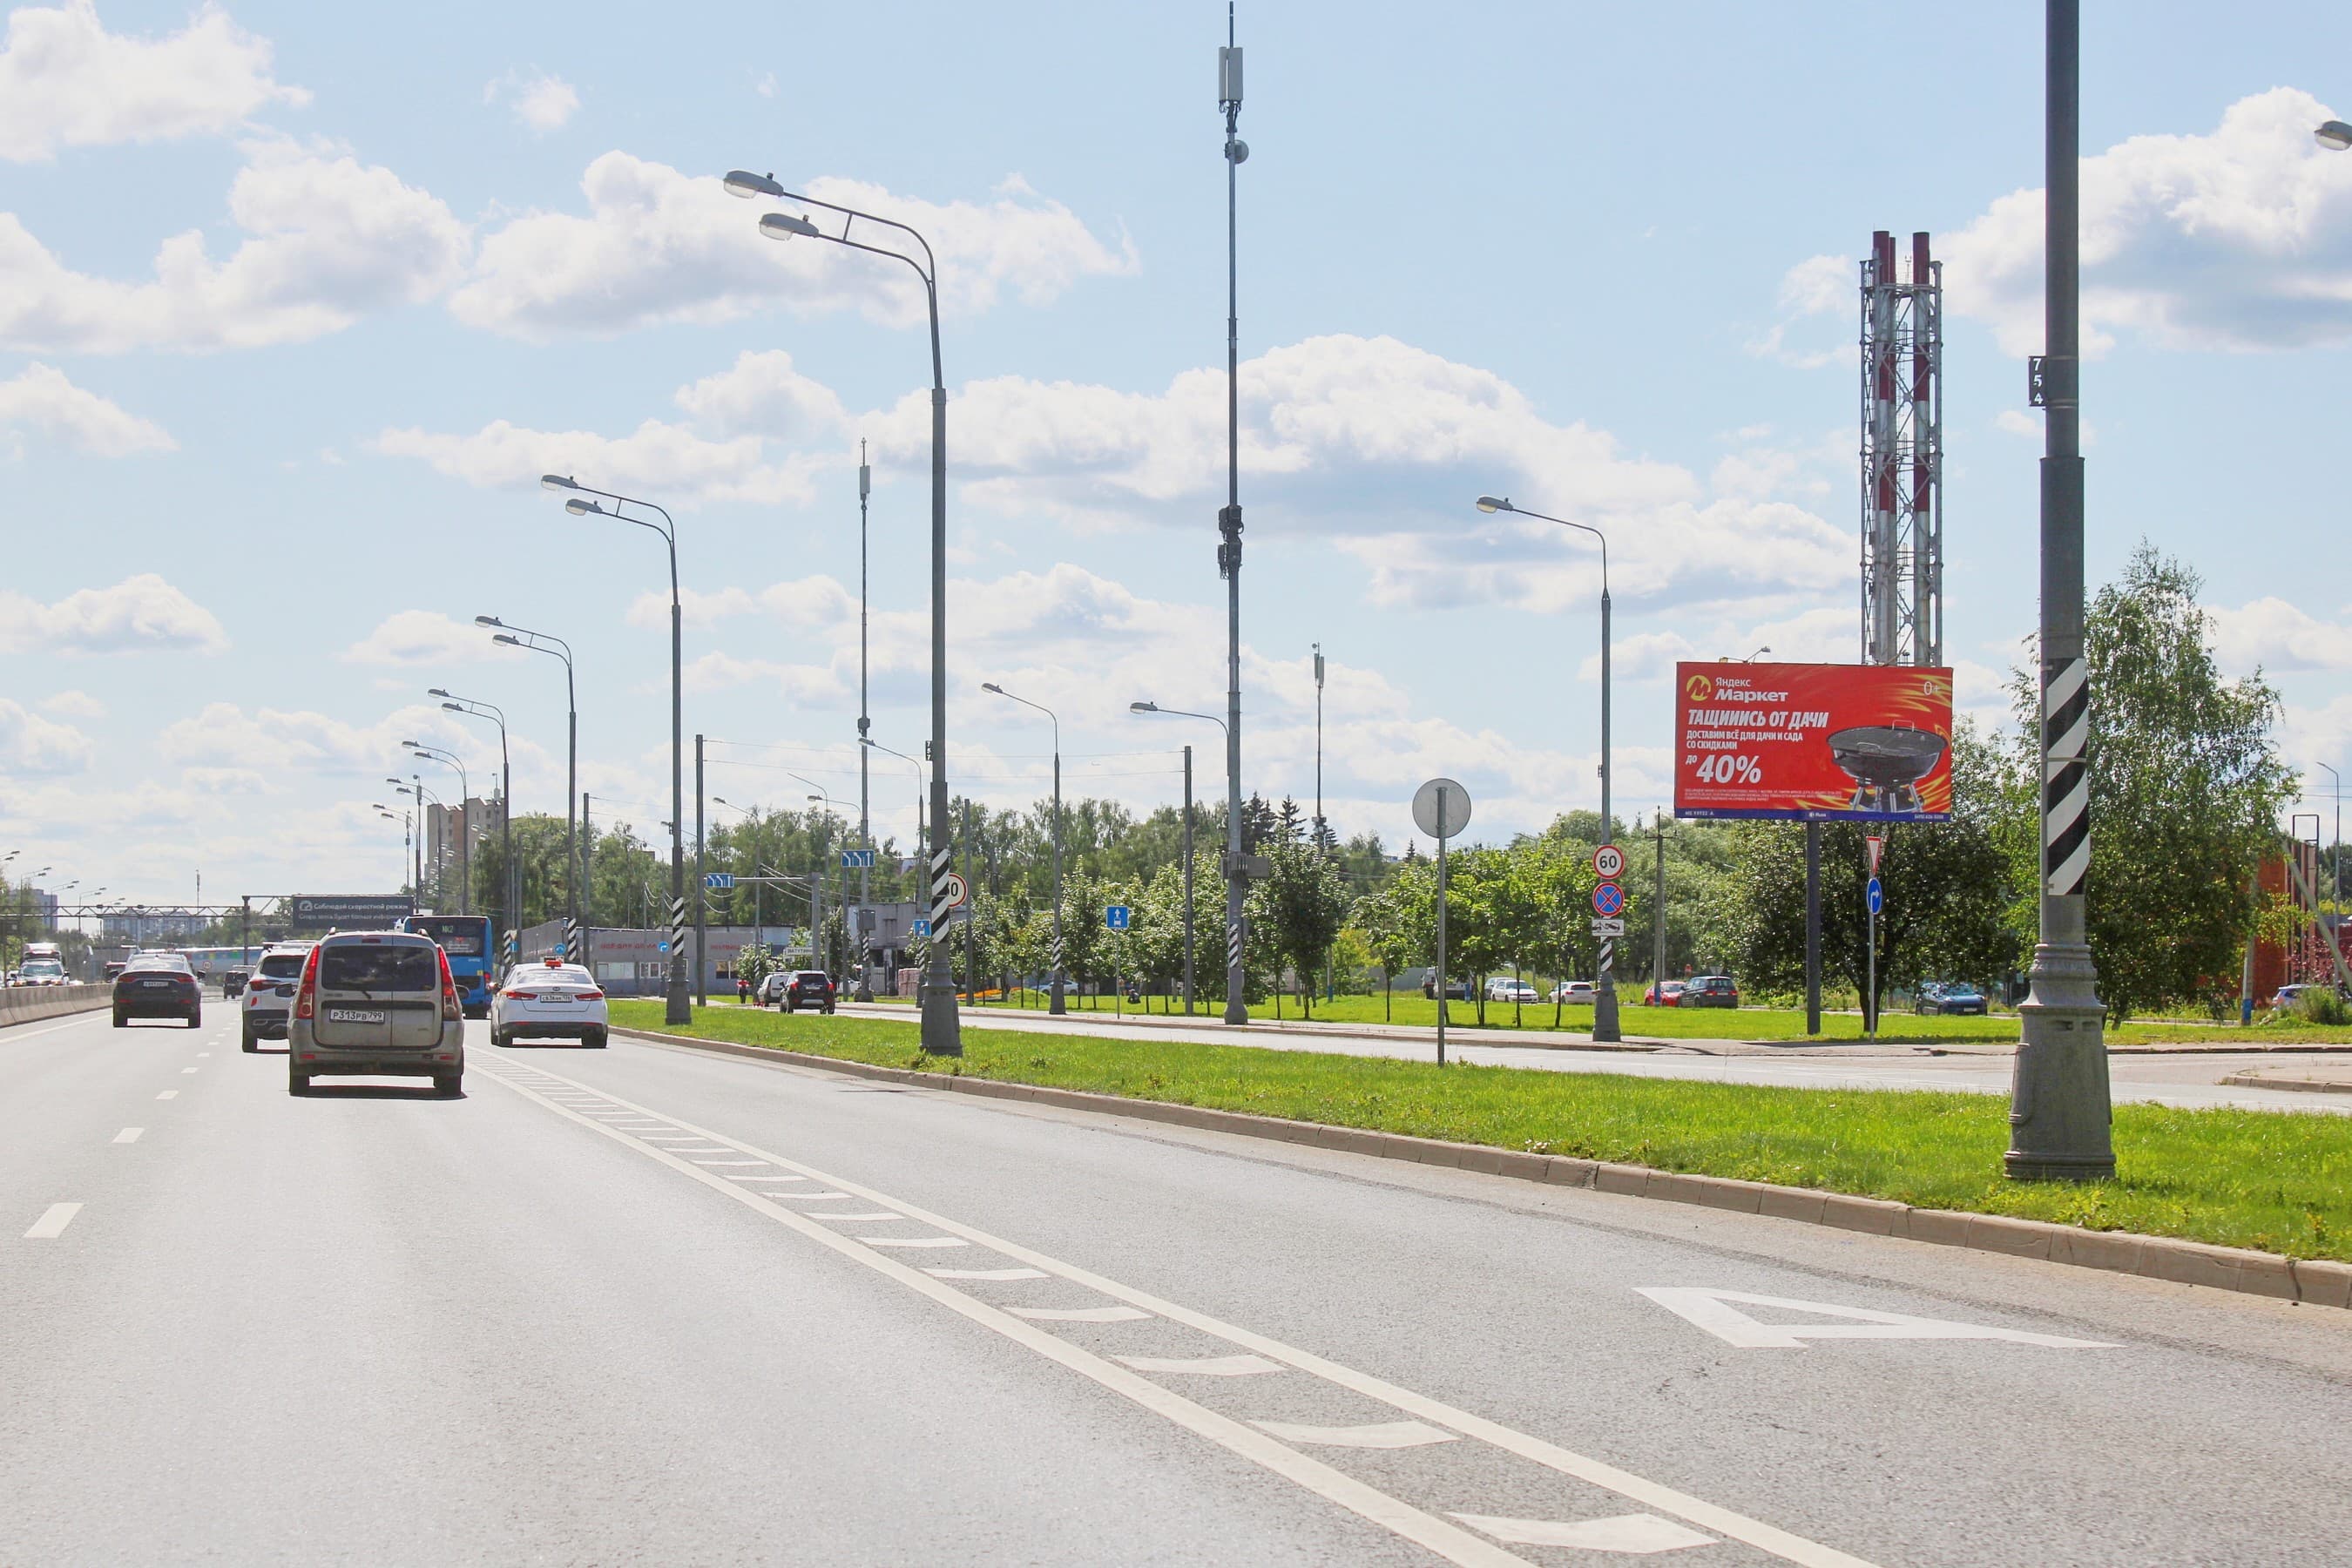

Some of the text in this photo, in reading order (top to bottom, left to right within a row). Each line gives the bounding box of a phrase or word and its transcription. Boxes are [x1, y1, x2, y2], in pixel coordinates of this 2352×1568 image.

[2032, 358, 2044, 404] 754
[1715, 677, 1751, 687] Яндекс
[1714, 688, 1788, 703] Маркет
[1768, 711, 1788, 727] ОТ
[1788, 712, 1829, 730] ДАЧИ
[1686, 730, 1726, 740] ДОСТАВИМ
[1727, 729, 1739, 740] ВСЁ
[1740, 732, 1755, 741] ДЛЯ
[1756, 732, 1776, 741] ДАЧИ
[1783, 733, 1803, 742] САДА
[1686, 740, 1738, 750] СО СКИДКАМИ
[1695, 754, 1761, 784] 40%
[1599, 855, 1617, 868] 60
